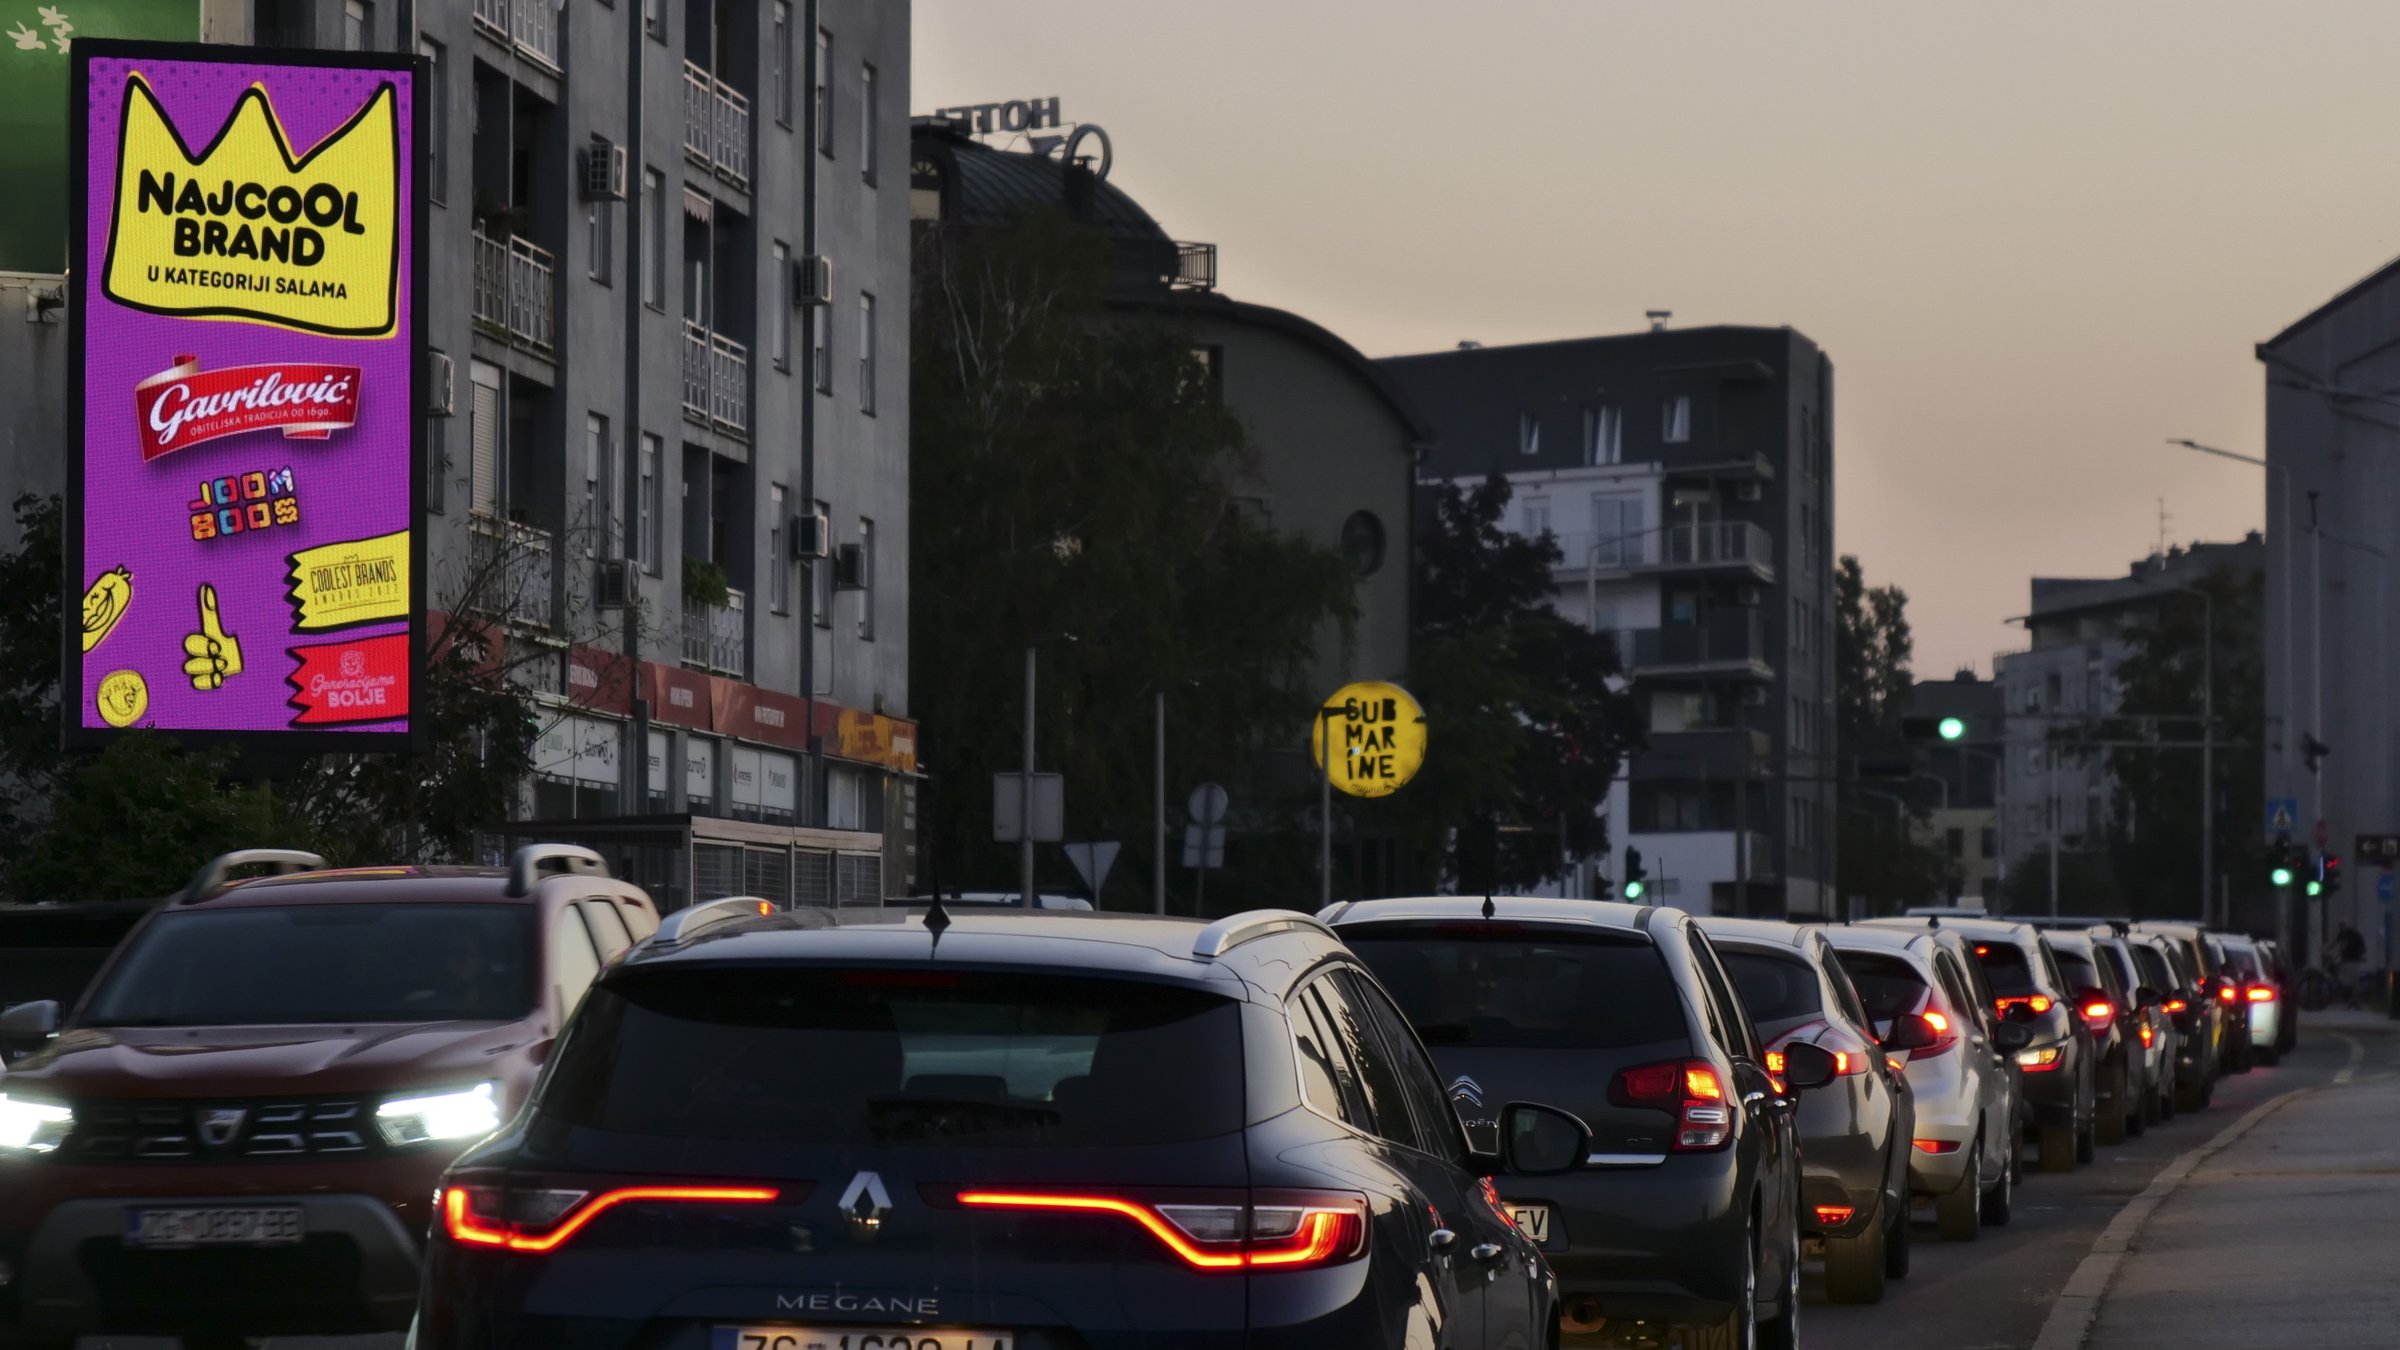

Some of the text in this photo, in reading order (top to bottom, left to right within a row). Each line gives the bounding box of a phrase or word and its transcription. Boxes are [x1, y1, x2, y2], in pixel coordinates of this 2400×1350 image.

[138, 169, 365, 235] NAJCOOL
[174, 218, 325, 267] BRAND
[148, 266, 347, 300] U KATEGORIJI SALAMA
[150, 372, 352, 445] Gavrilović
[190, 417, 241, 436] OBITELJSKA
[244, 411, 289, 425] TRADICIJA
[291, 408, 304, 418] OD
[189, 466, 294, 510] JOOM
[311, 560, 397, 593] COOLEST BRANDS
[328, 688, 386, 707] BOLJE
[1345, 698, 1397, 723] SUB
[1346, 724, 1396, 752] MAR
[1347, 755, 1395, 780] INE
[777, 1294, 939, 1315] MEGANE
